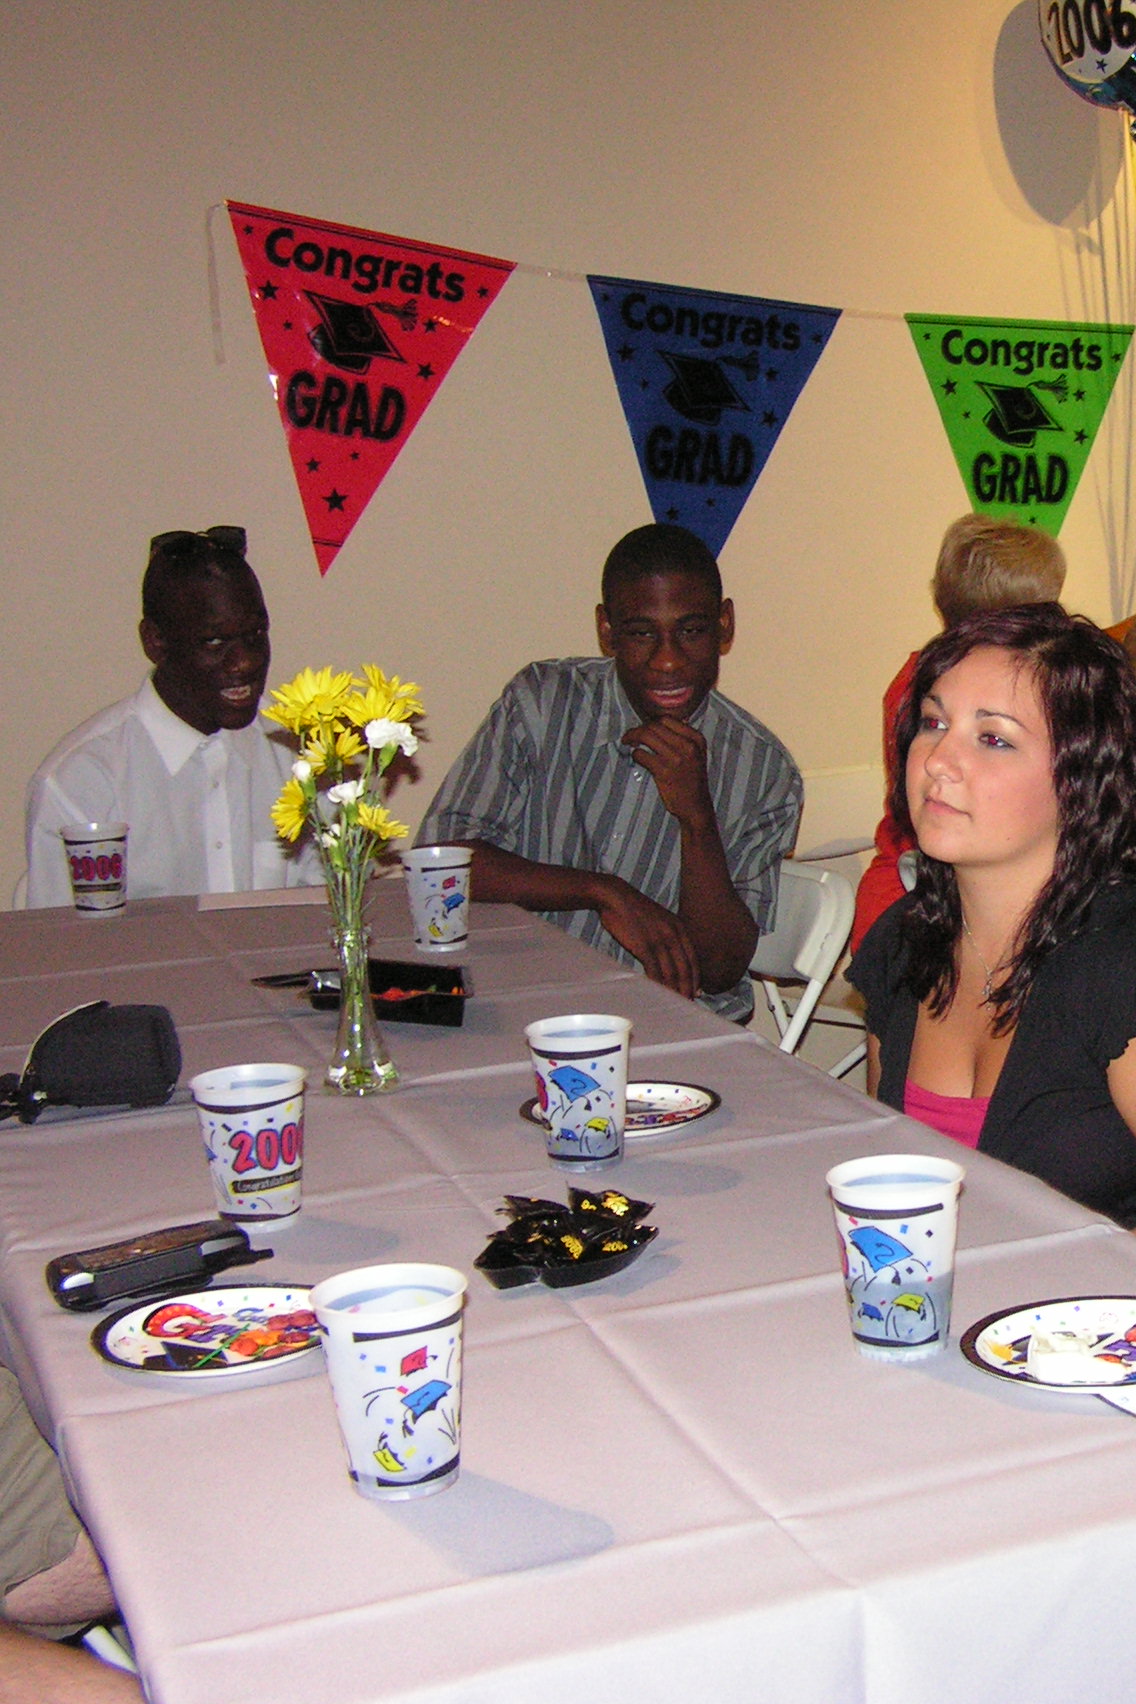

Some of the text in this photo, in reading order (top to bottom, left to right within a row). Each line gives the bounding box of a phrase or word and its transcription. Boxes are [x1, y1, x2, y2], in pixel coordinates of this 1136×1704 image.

[264, 228, 467, 304] Congrats
[620, 293, 801, 352] Congrats
[941, 329, 1103, 375] Congrats
[286, 370, 407, 442] GRAD
[644, 425, 755, 487] GRAD
[971, 451, 1068, 504] GRAD
